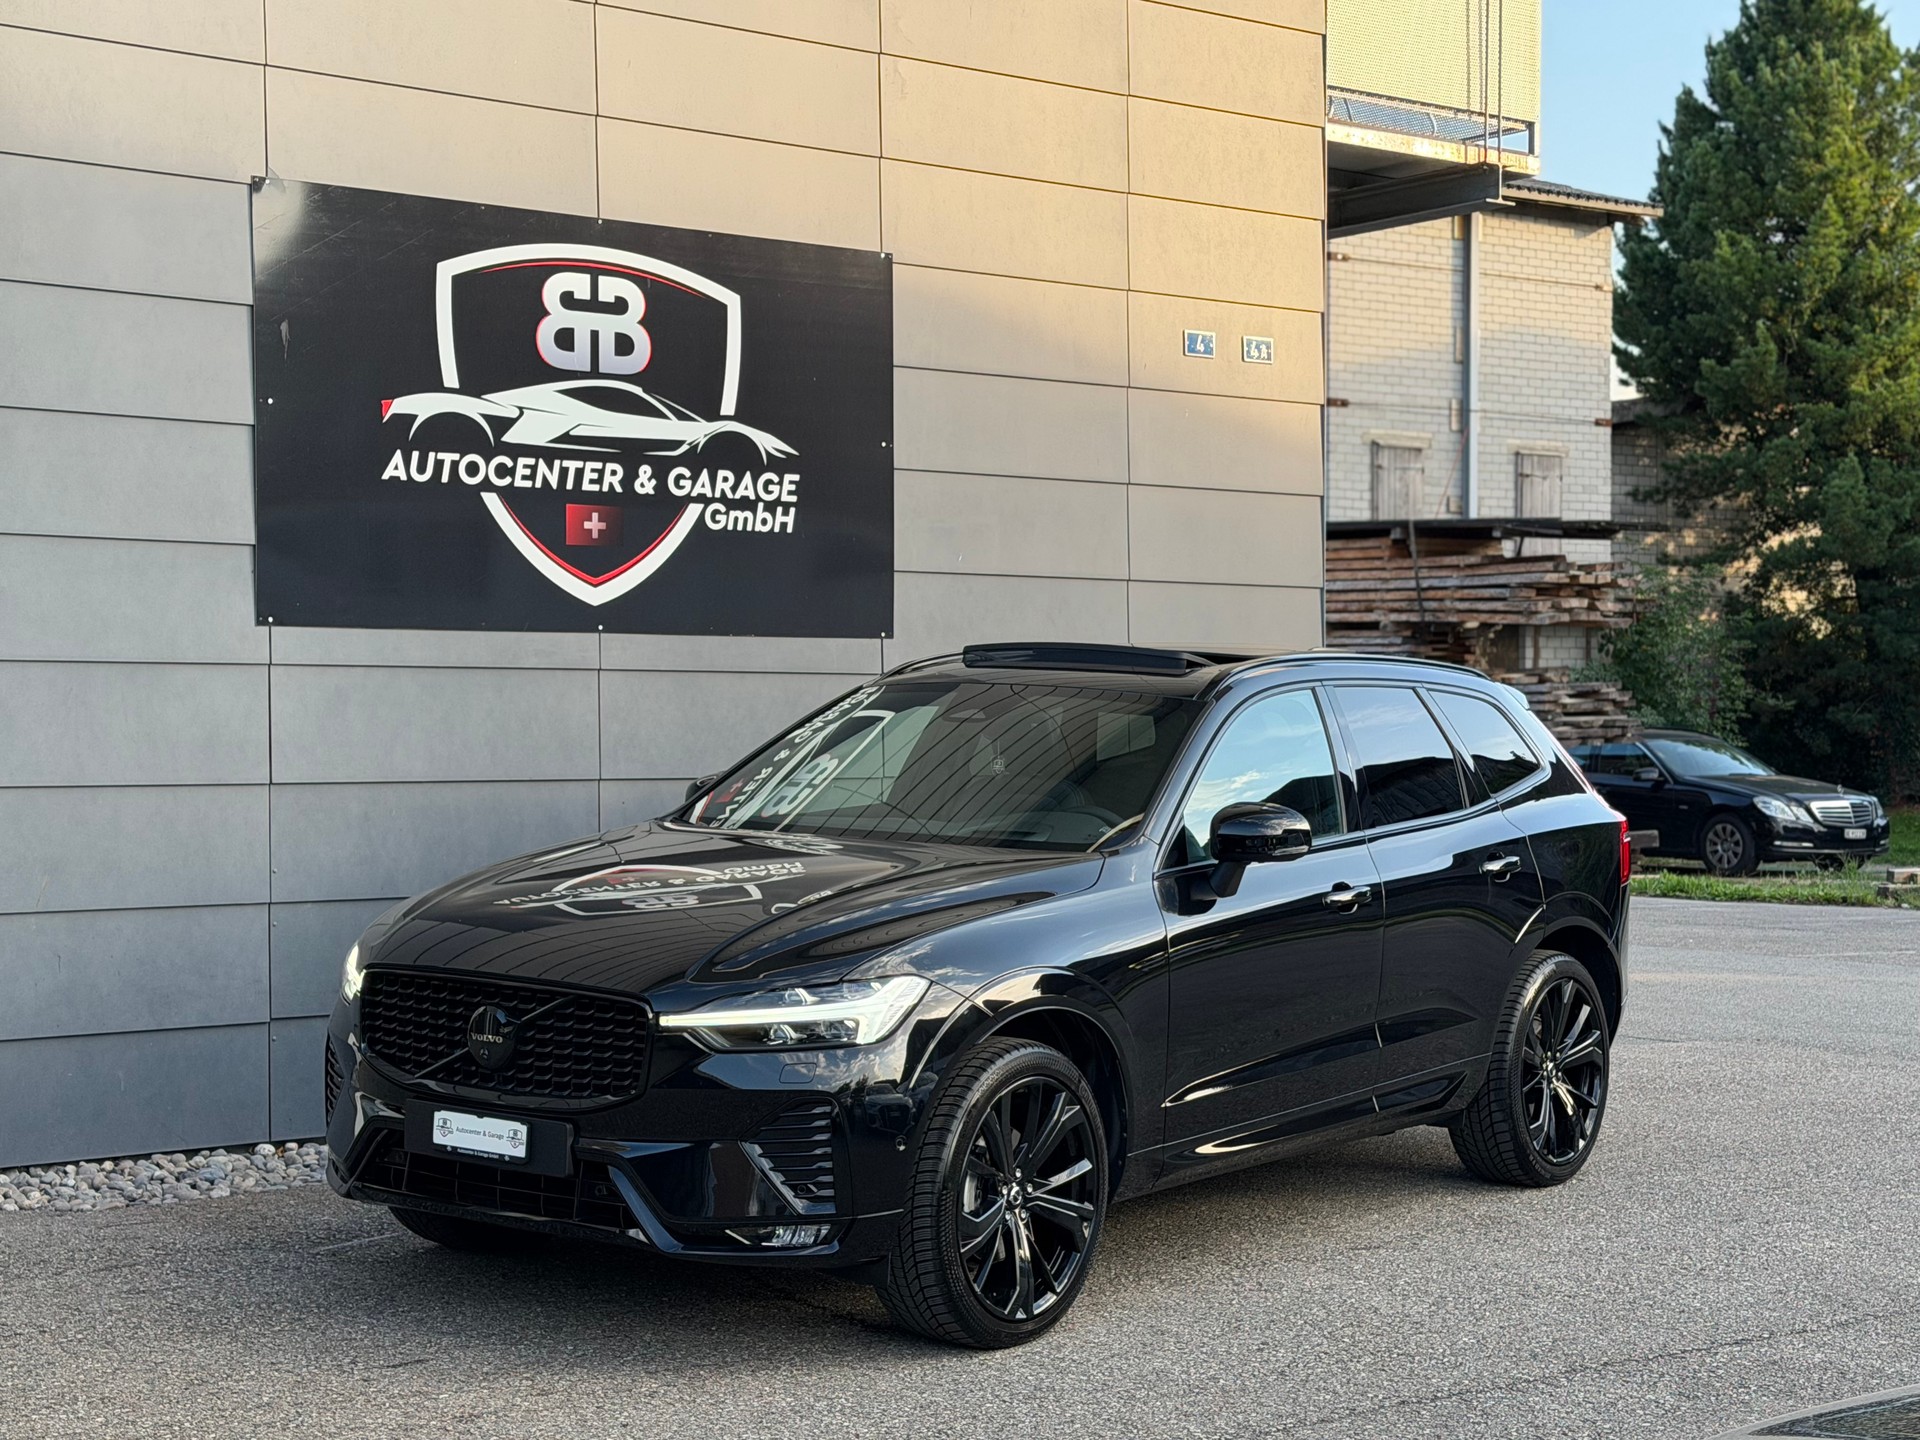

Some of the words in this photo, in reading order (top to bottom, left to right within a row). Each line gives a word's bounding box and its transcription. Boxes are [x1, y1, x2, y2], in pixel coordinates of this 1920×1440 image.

[1196, 334, 1205, 353] 4
[381, 448, 623, 495] AUTOCENTER
[634, 465, 657, 495] &
[667, 467, 800, 503] GARAGE
[704, 503, 798, 534] GmbH
[471, 1032, 503, 1044] VOLVO
[456, 1126, 482, 1136] Autocenter
[487, 1131, 505, 1141] Garage
